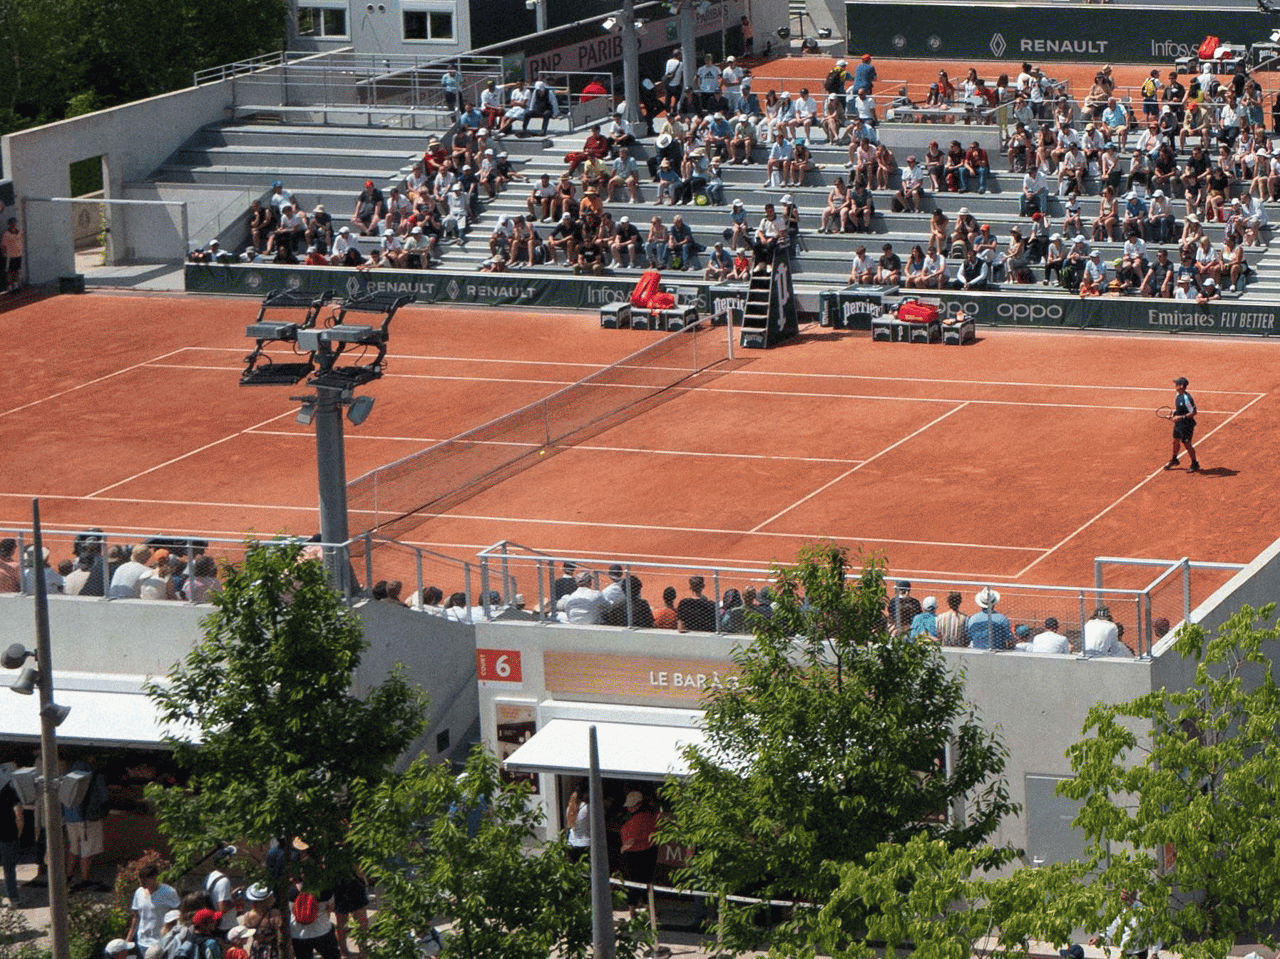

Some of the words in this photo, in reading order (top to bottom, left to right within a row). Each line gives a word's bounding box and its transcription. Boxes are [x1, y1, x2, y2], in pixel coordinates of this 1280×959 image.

[1020, 38, 1108, 54] RENAULT
[366, 281, 435, 295] RENAULT
[466, 284, 537, 299] RENAULT
[842, 298, 882, 326] perrier
[997, 303, 1063, 319] oppo
[1147, 309, 1215, 328] Emirates
[1220, 312, 1239, 329] FLY
[1241, 312, 1275, 332] BETTER
[496, 654, 511, 678] 6
[650, 671, 668, 686] LE
[673, 672, 706, 688] BAR
